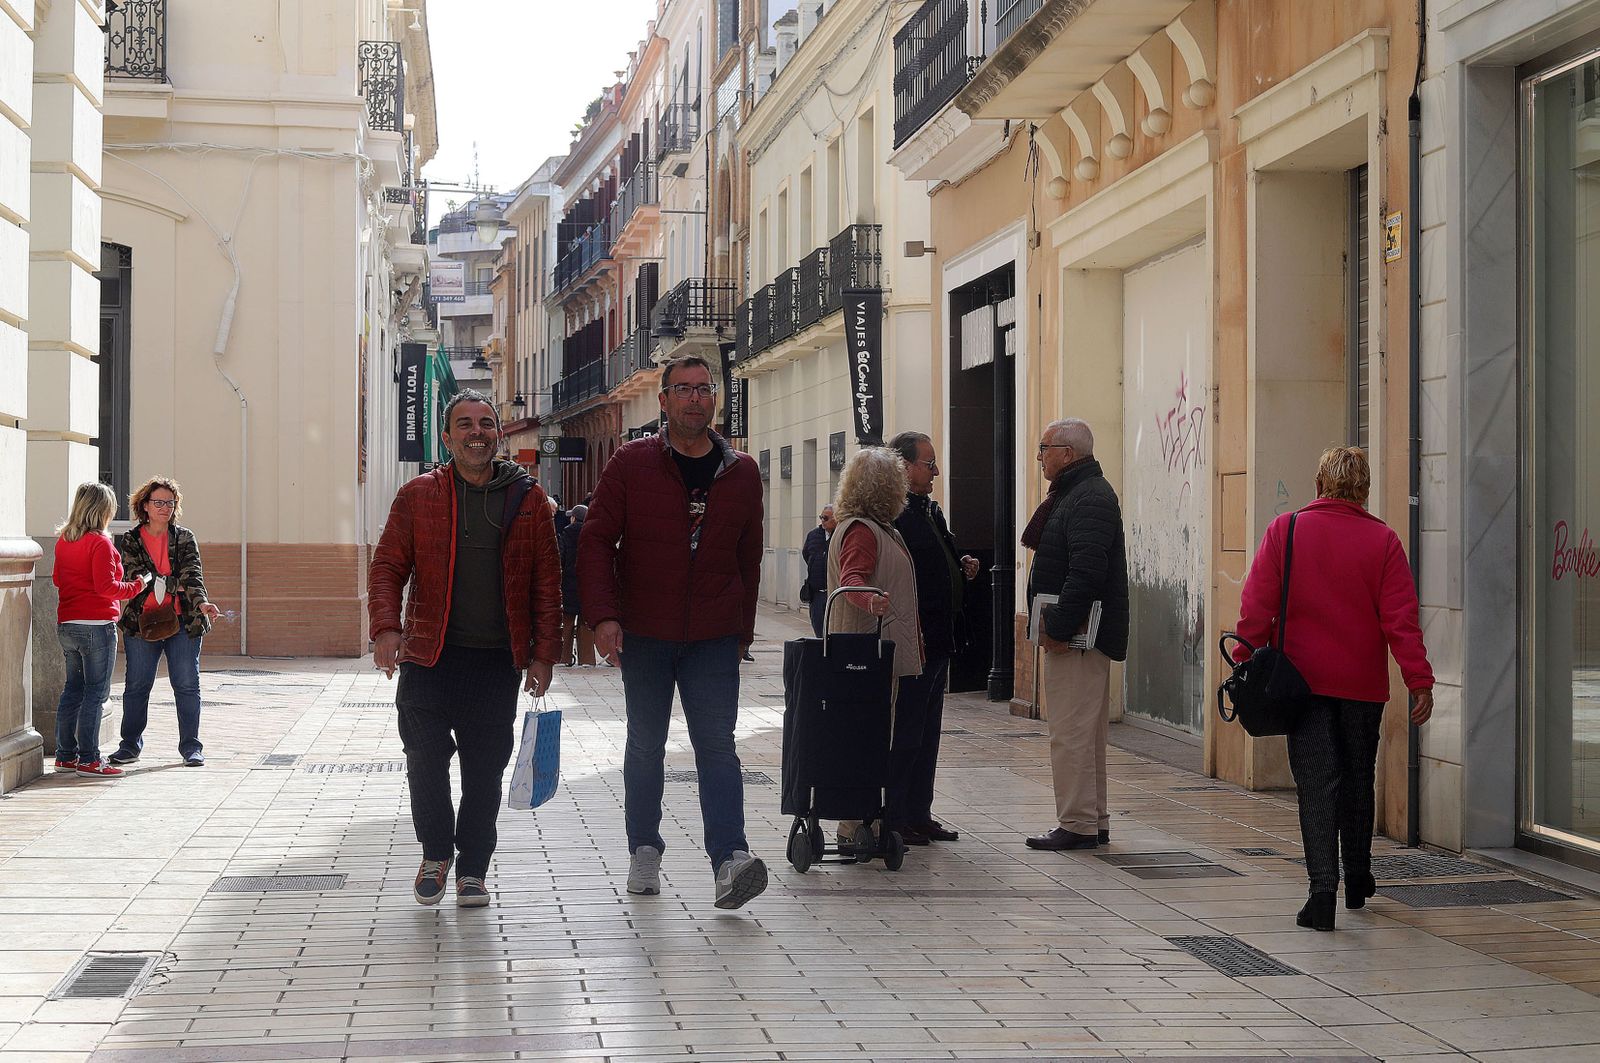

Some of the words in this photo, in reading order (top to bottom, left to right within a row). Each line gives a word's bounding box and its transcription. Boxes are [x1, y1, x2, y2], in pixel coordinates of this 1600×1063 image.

[854, 301, 866, 347] VIAJES
[407, 364, 418, 393] LOLA
[407, 395, 416, 404] Y
[406, 404, 416, 441] BIMBA
[1552, 520, 1600, 581] Barbie
